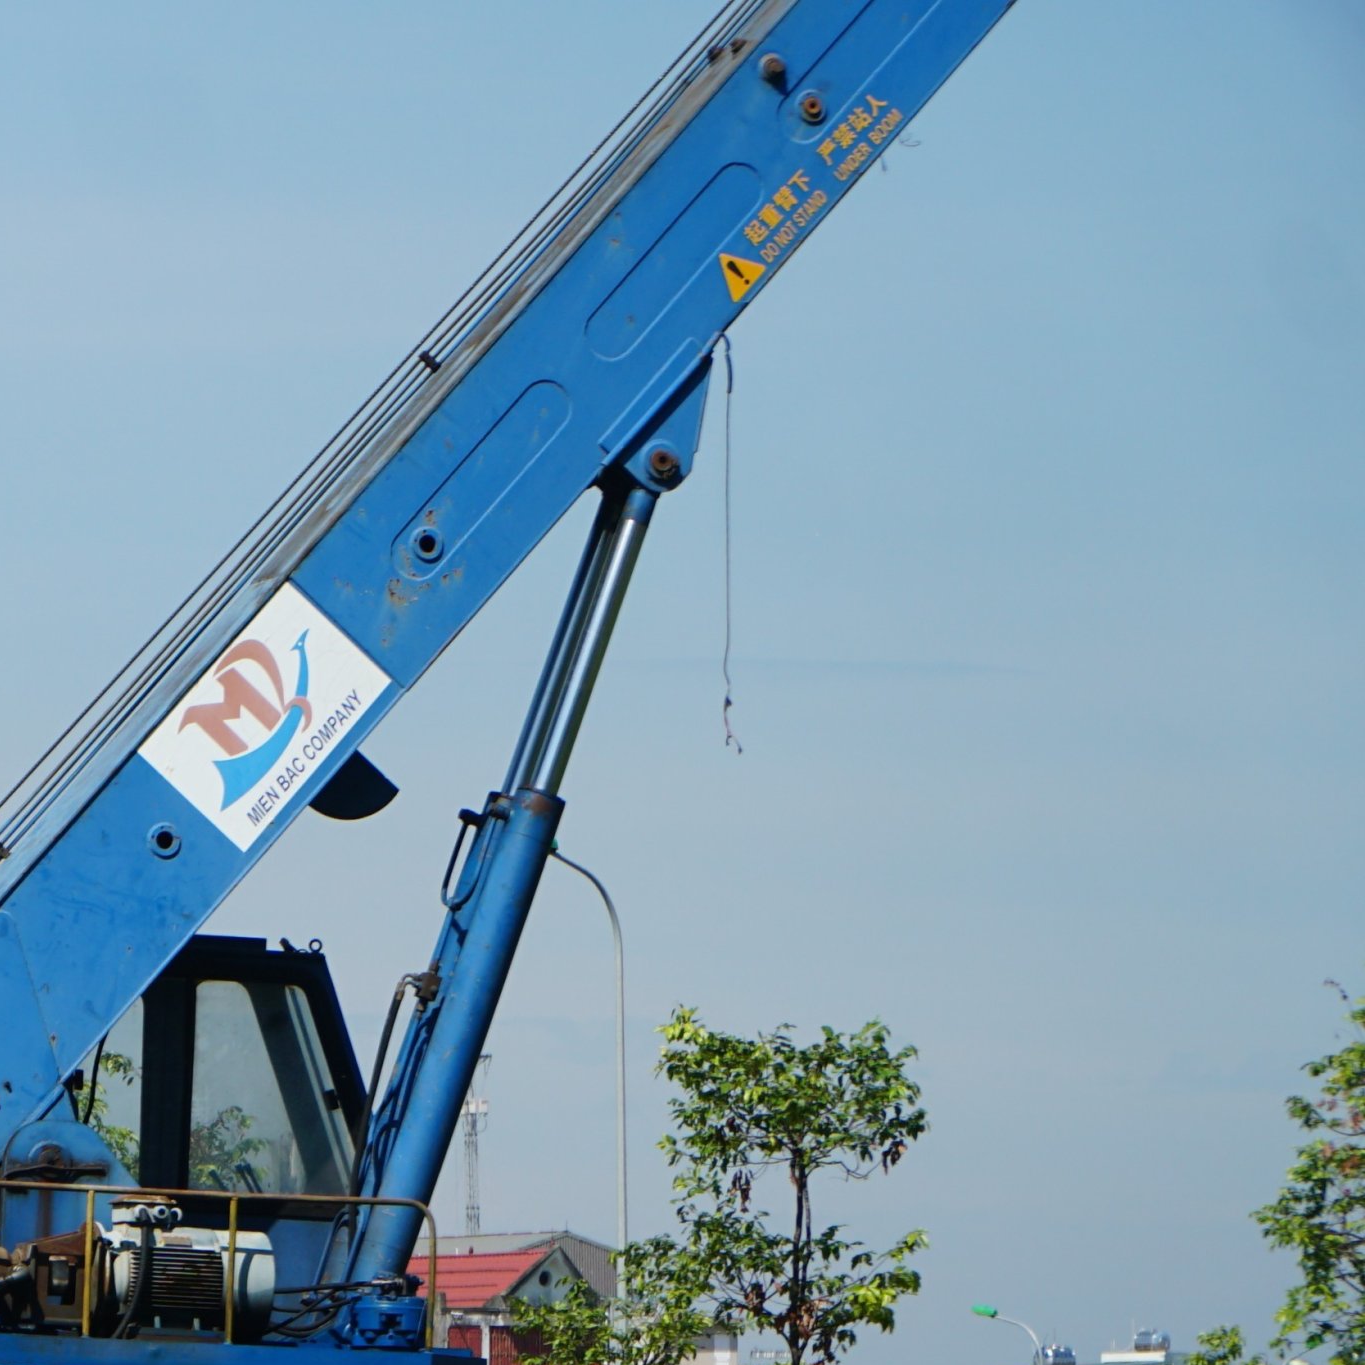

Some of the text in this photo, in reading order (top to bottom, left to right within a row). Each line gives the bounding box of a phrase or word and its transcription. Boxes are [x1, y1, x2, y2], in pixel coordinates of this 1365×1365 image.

[760, 108, 903, 263] DO NOT STAND UNDER BOOM
[816, 94, 888, 166] 严禁站人
[246, 689, 362, 827] MIEN BAC COMPANY
